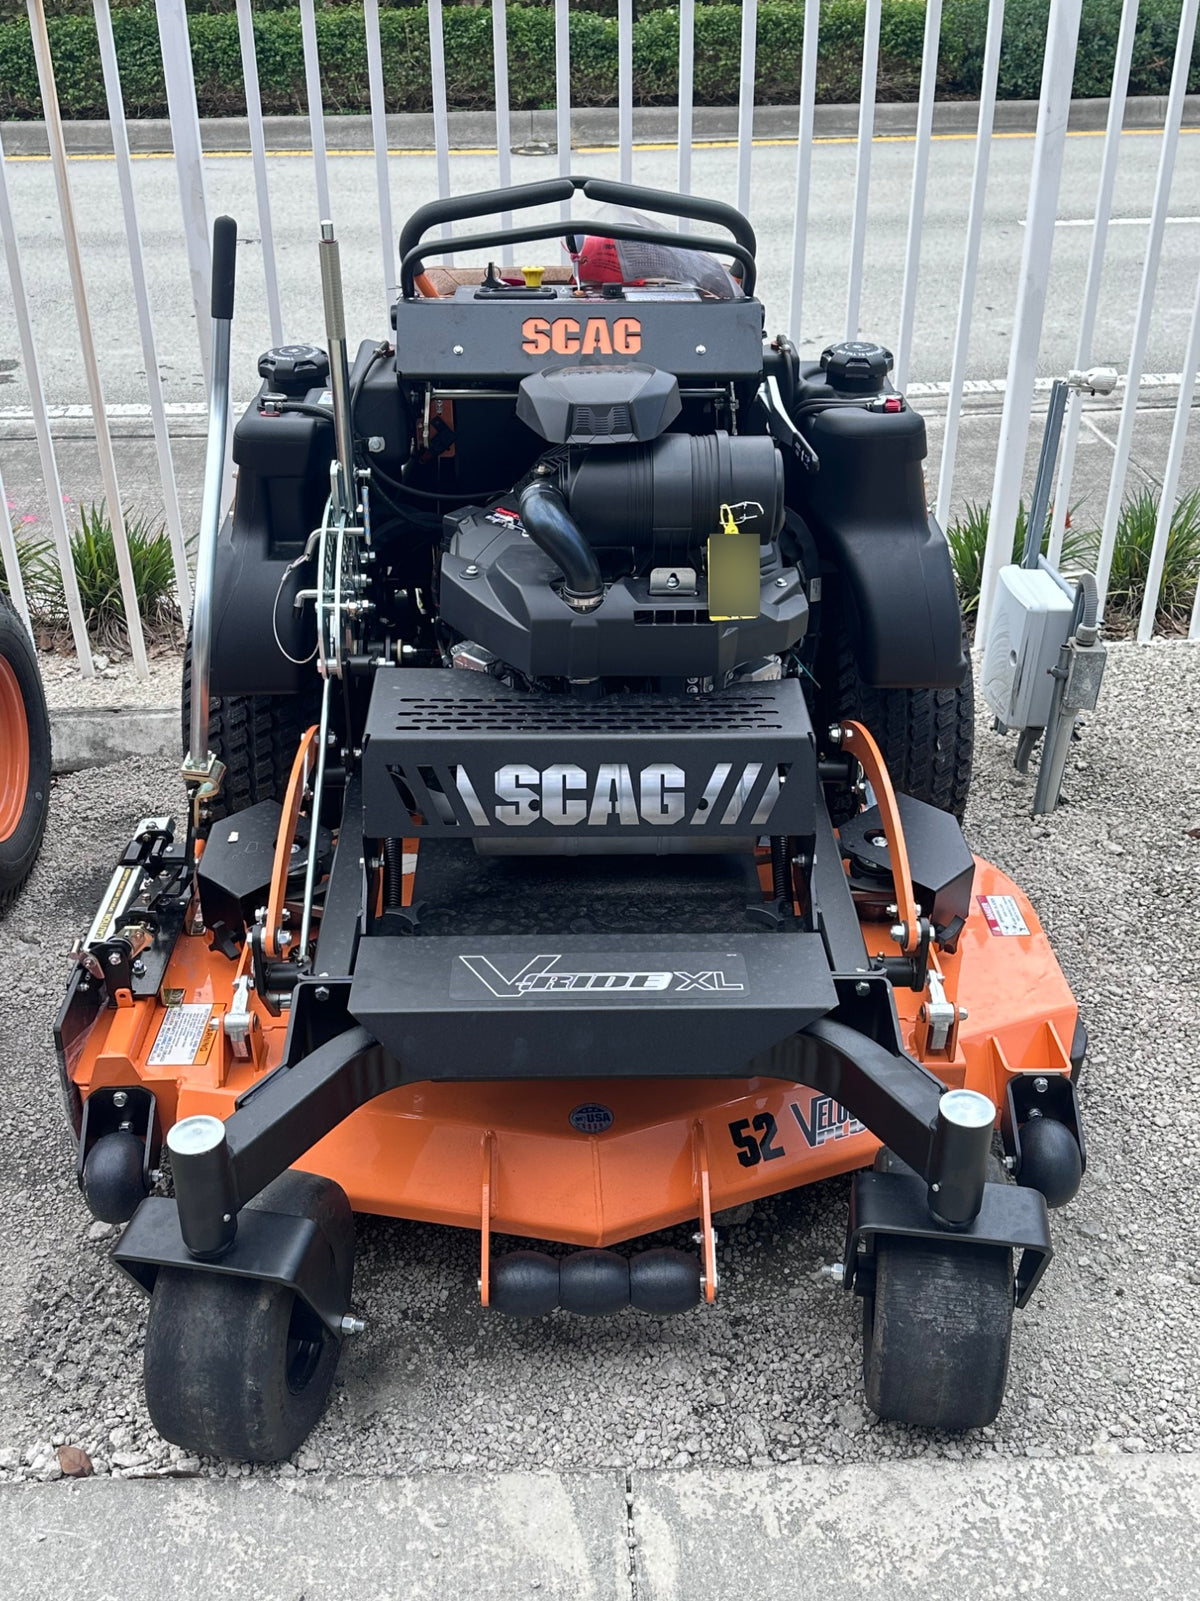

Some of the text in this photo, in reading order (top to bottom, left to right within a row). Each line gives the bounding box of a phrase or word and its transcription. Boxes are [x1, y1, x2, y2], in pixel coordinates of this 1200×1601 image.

[521, 316, 642, 356] SCAG
[494, 762, 686, 826] SCAG
[674, 971, 745, 991] XL
[199, 1023, 214, 1052] ARNING
[586, 1112, 611, 1123] USA
[788, 1094, 858, 1150] VELO
[727, 1111, 786, 1169] 52
